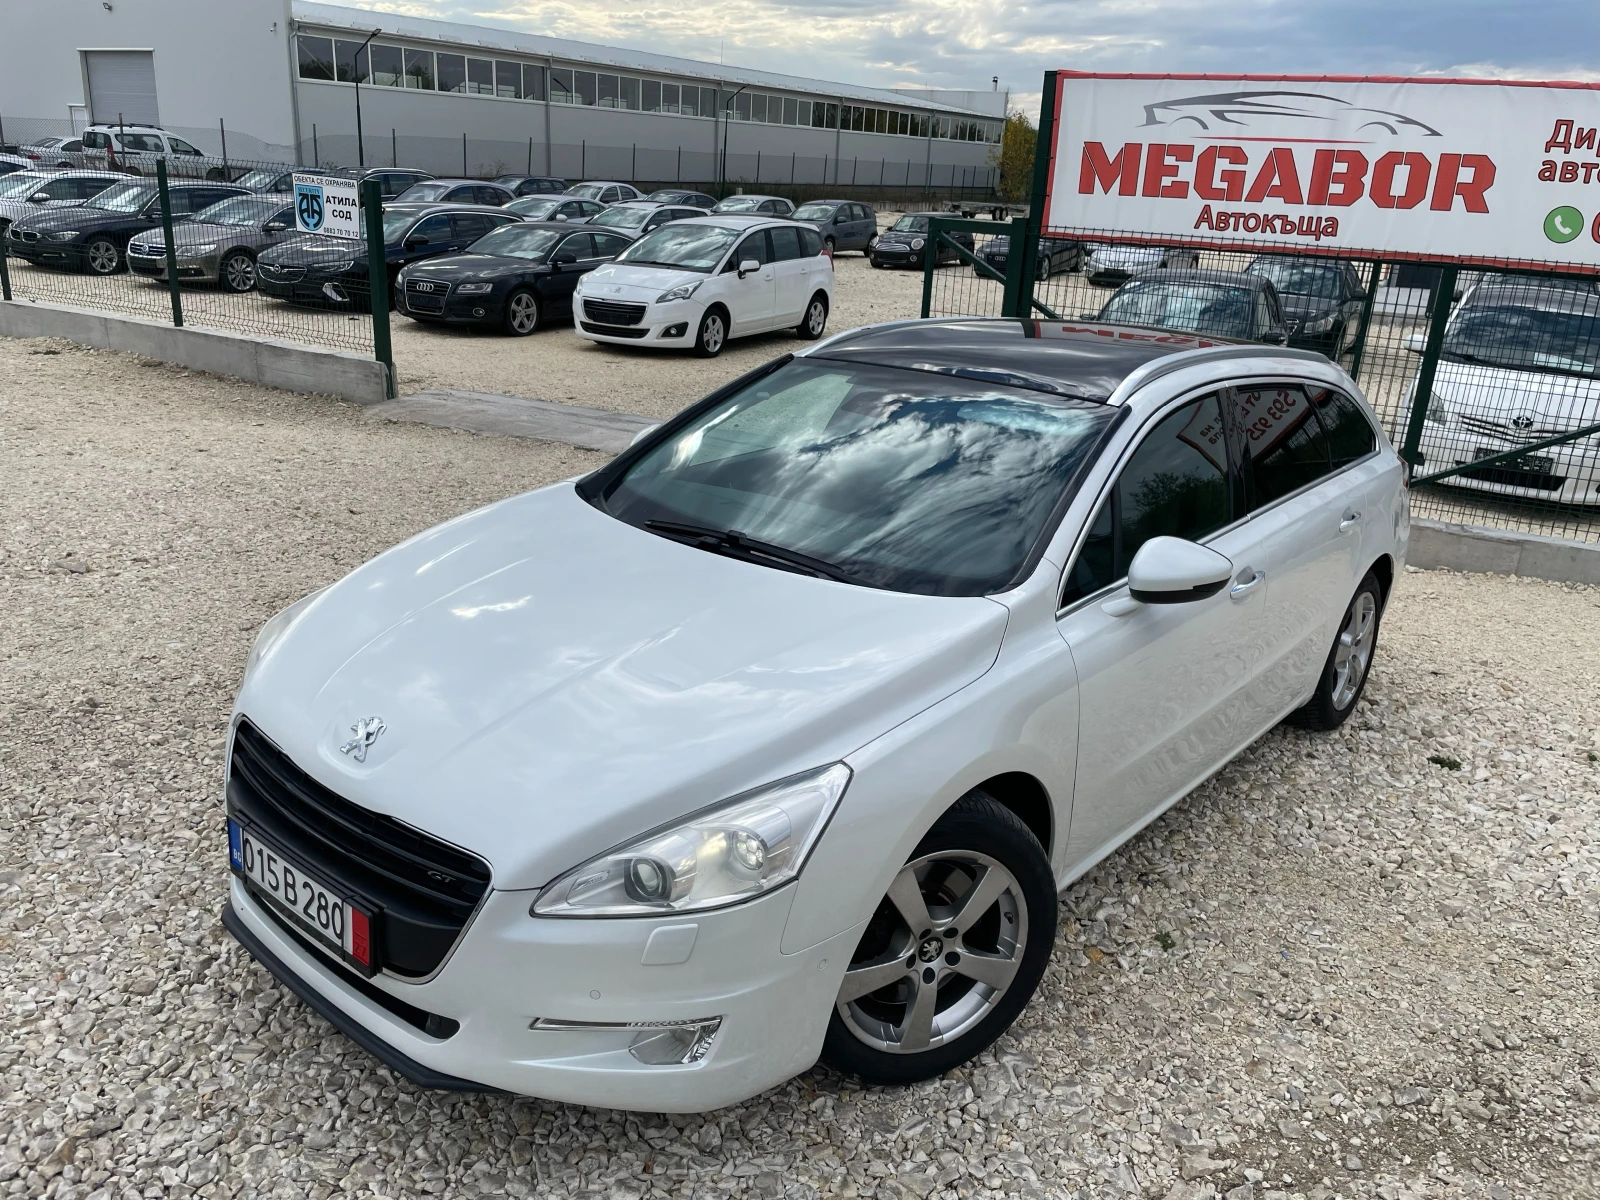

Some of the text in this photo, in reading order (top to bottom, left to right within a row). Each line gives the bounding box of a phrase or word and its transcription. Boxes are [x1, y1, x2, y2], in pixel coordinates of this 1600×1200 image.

[1544, 119, 1600, 157] Ди
[1079, 141, 1497, 214] MEGABOR
[1538, 159, 1600, 184] авт
[325, 179, 356, 188] ОХРАНЯВА
[325, 195, 358, 208] АТИЛА
[331, 209, 352, 221] СОД
[1194, 205, 1339, 241] Автокъща
[336, 228, 344, 236] 70
[427, 870, 457, 883] GT
